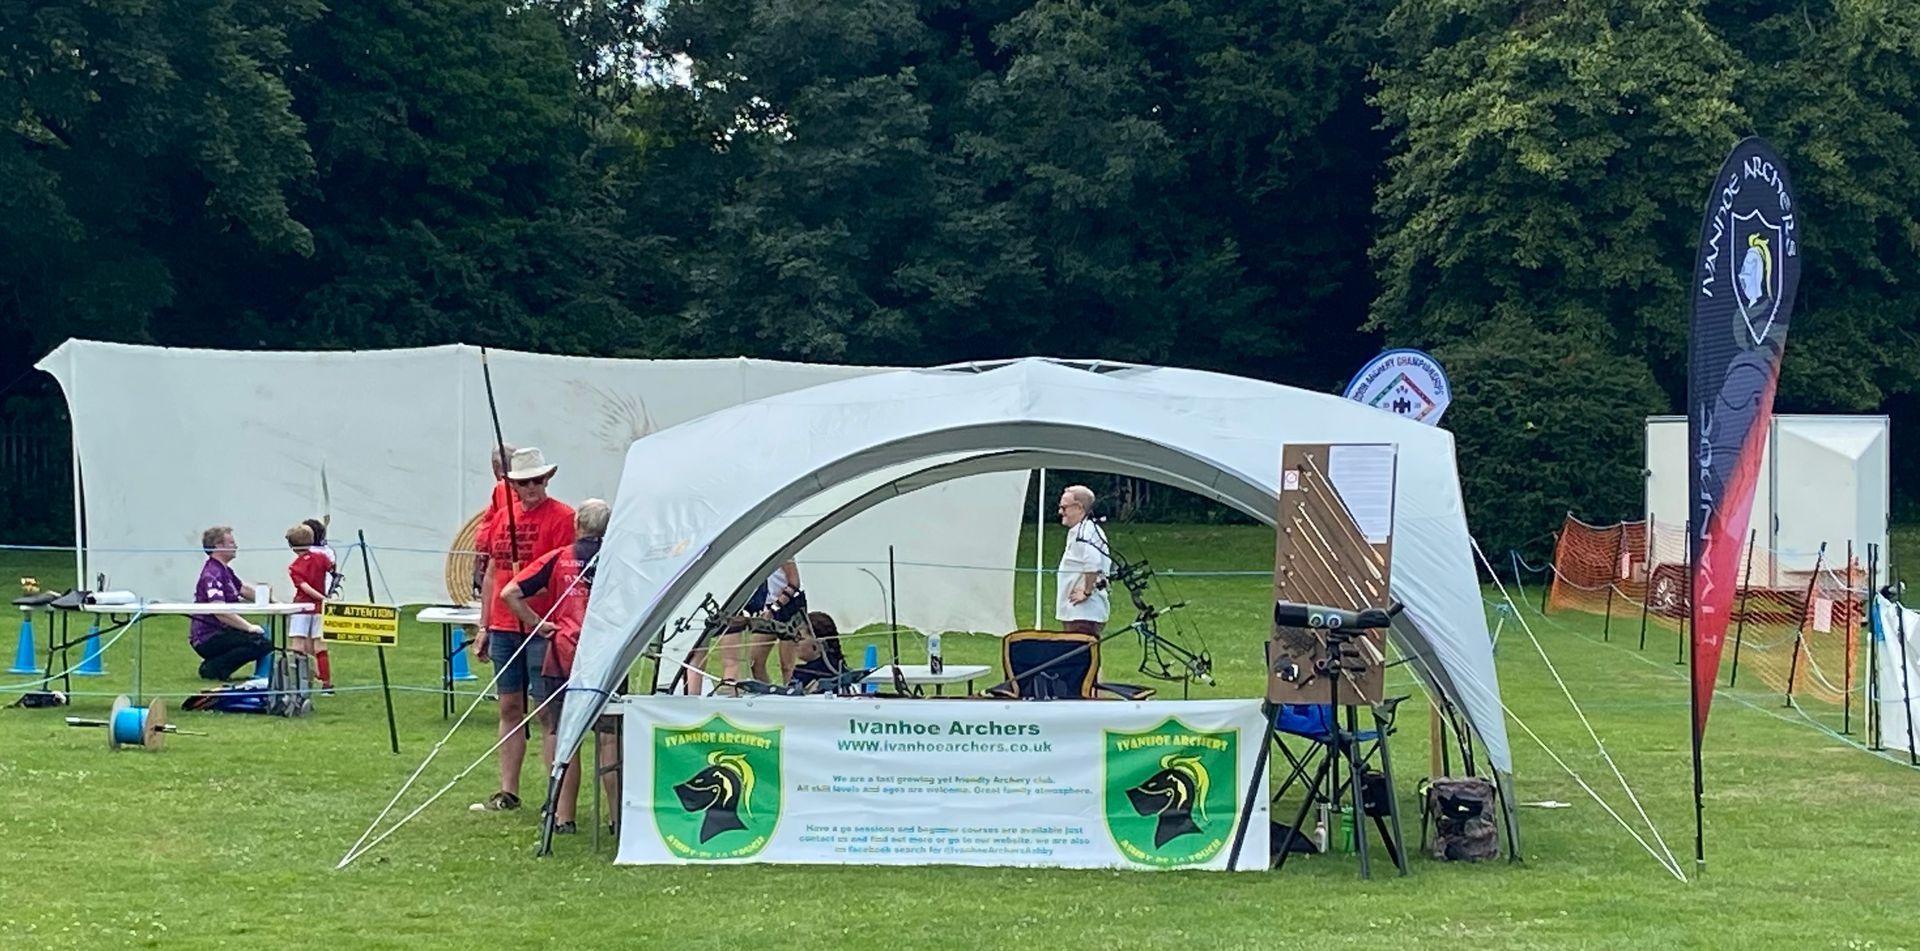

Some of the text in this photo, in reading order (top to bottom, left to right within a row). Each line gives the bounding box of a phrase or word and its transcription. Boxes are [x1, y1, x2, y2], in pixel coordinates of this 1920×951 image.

[1702, 172, 1740, 298] IVANHOE
[344, 606, 394, 618] ATTENTION
[850, 718, 1040, 736] Ivanhoe Archers
[664, 732, 772, 750] IVANHOE ARCHERS
[1116, 735, 1228, 752] IVANHOE ARCHERS
[832, 775, 846, 783] We
